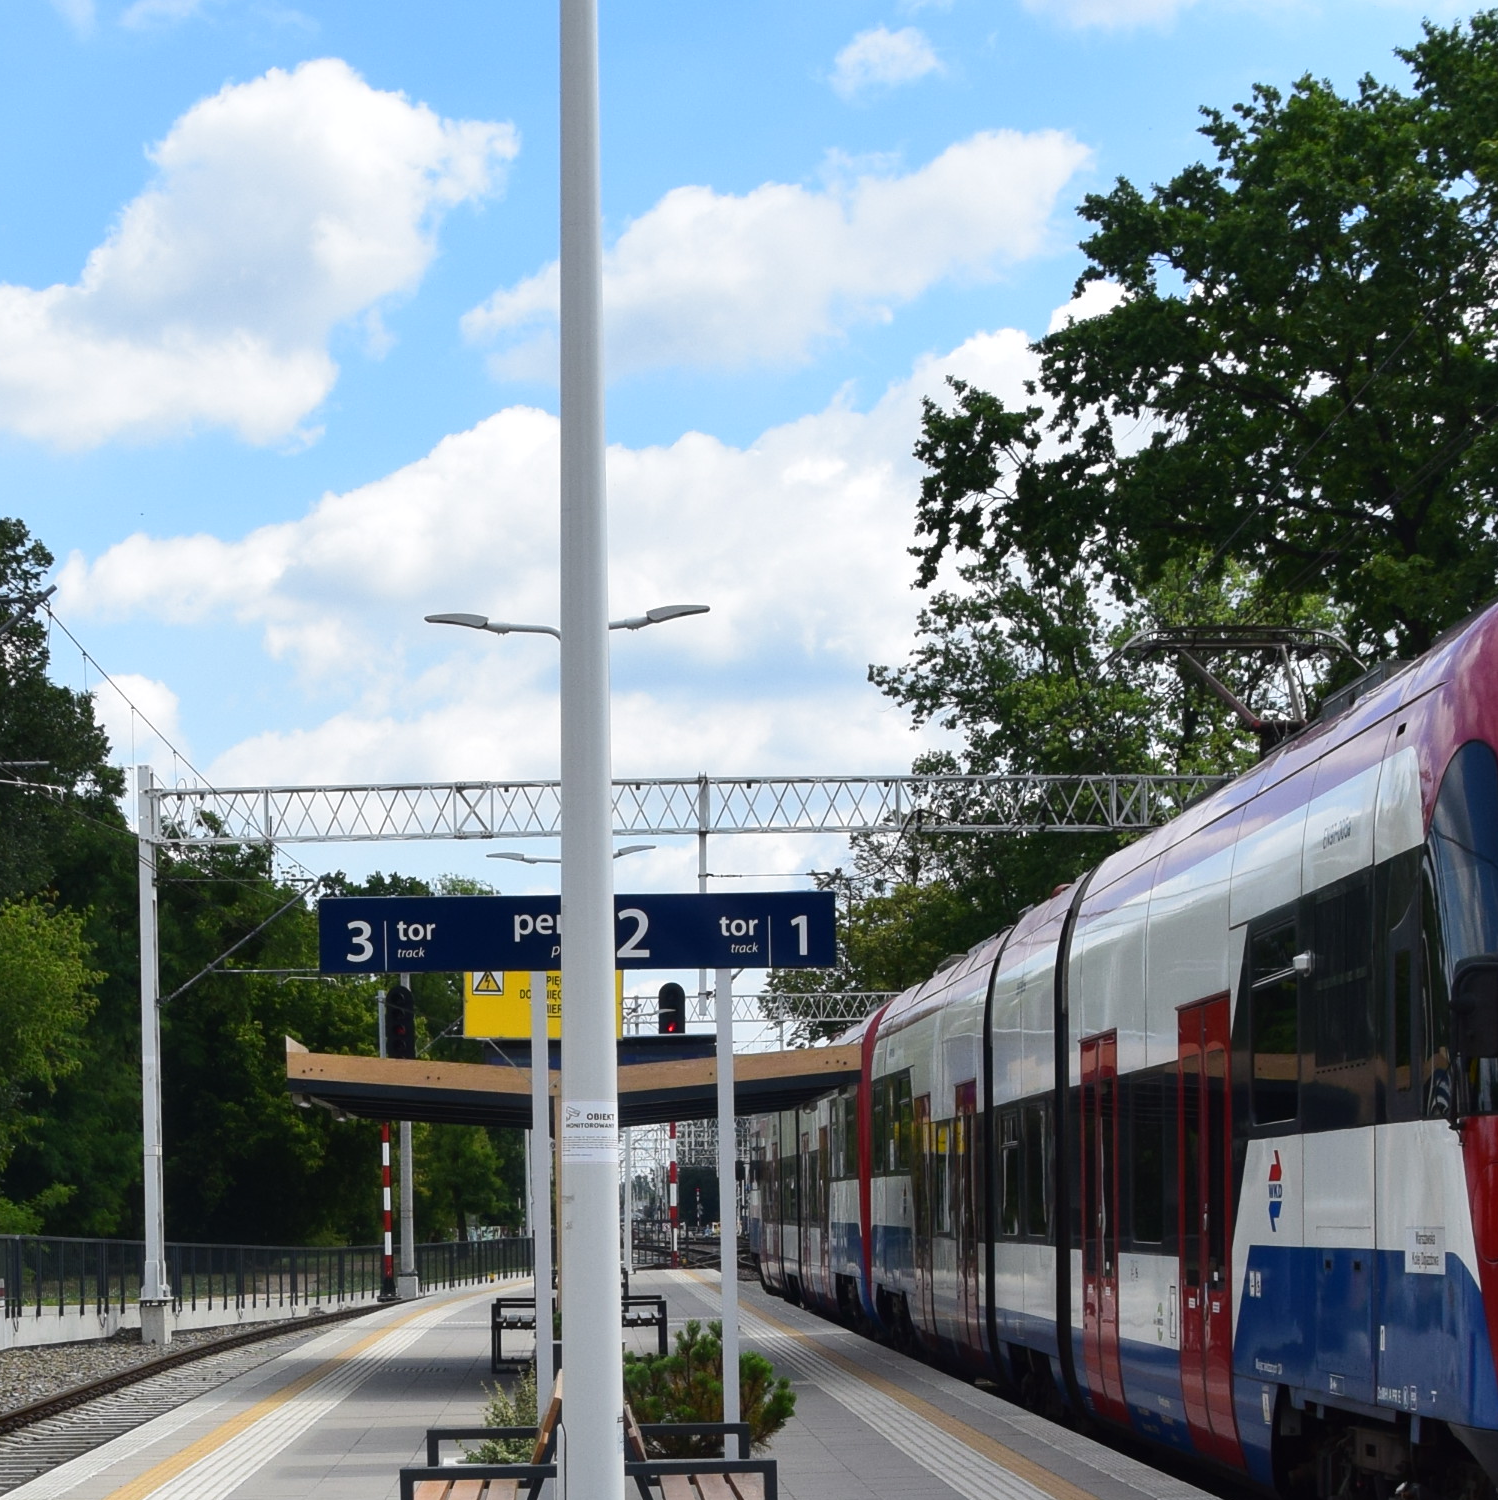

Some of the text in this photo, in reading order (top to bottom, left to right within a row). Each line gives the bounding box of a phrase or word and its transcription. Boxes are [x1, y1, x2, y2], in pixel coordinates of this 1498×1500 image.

[396, 921, 436, 941] tor
[616, 908, 650, 958] 2
[719, 916, 759, 937] tor
[790, 915, 808, 956] 1
[346, 920, 374, 963] 3
[730, 942, 759, 954] track
[397, 947, 425, 958] track
[586, 1112, 615, 1121] OBIEKT
